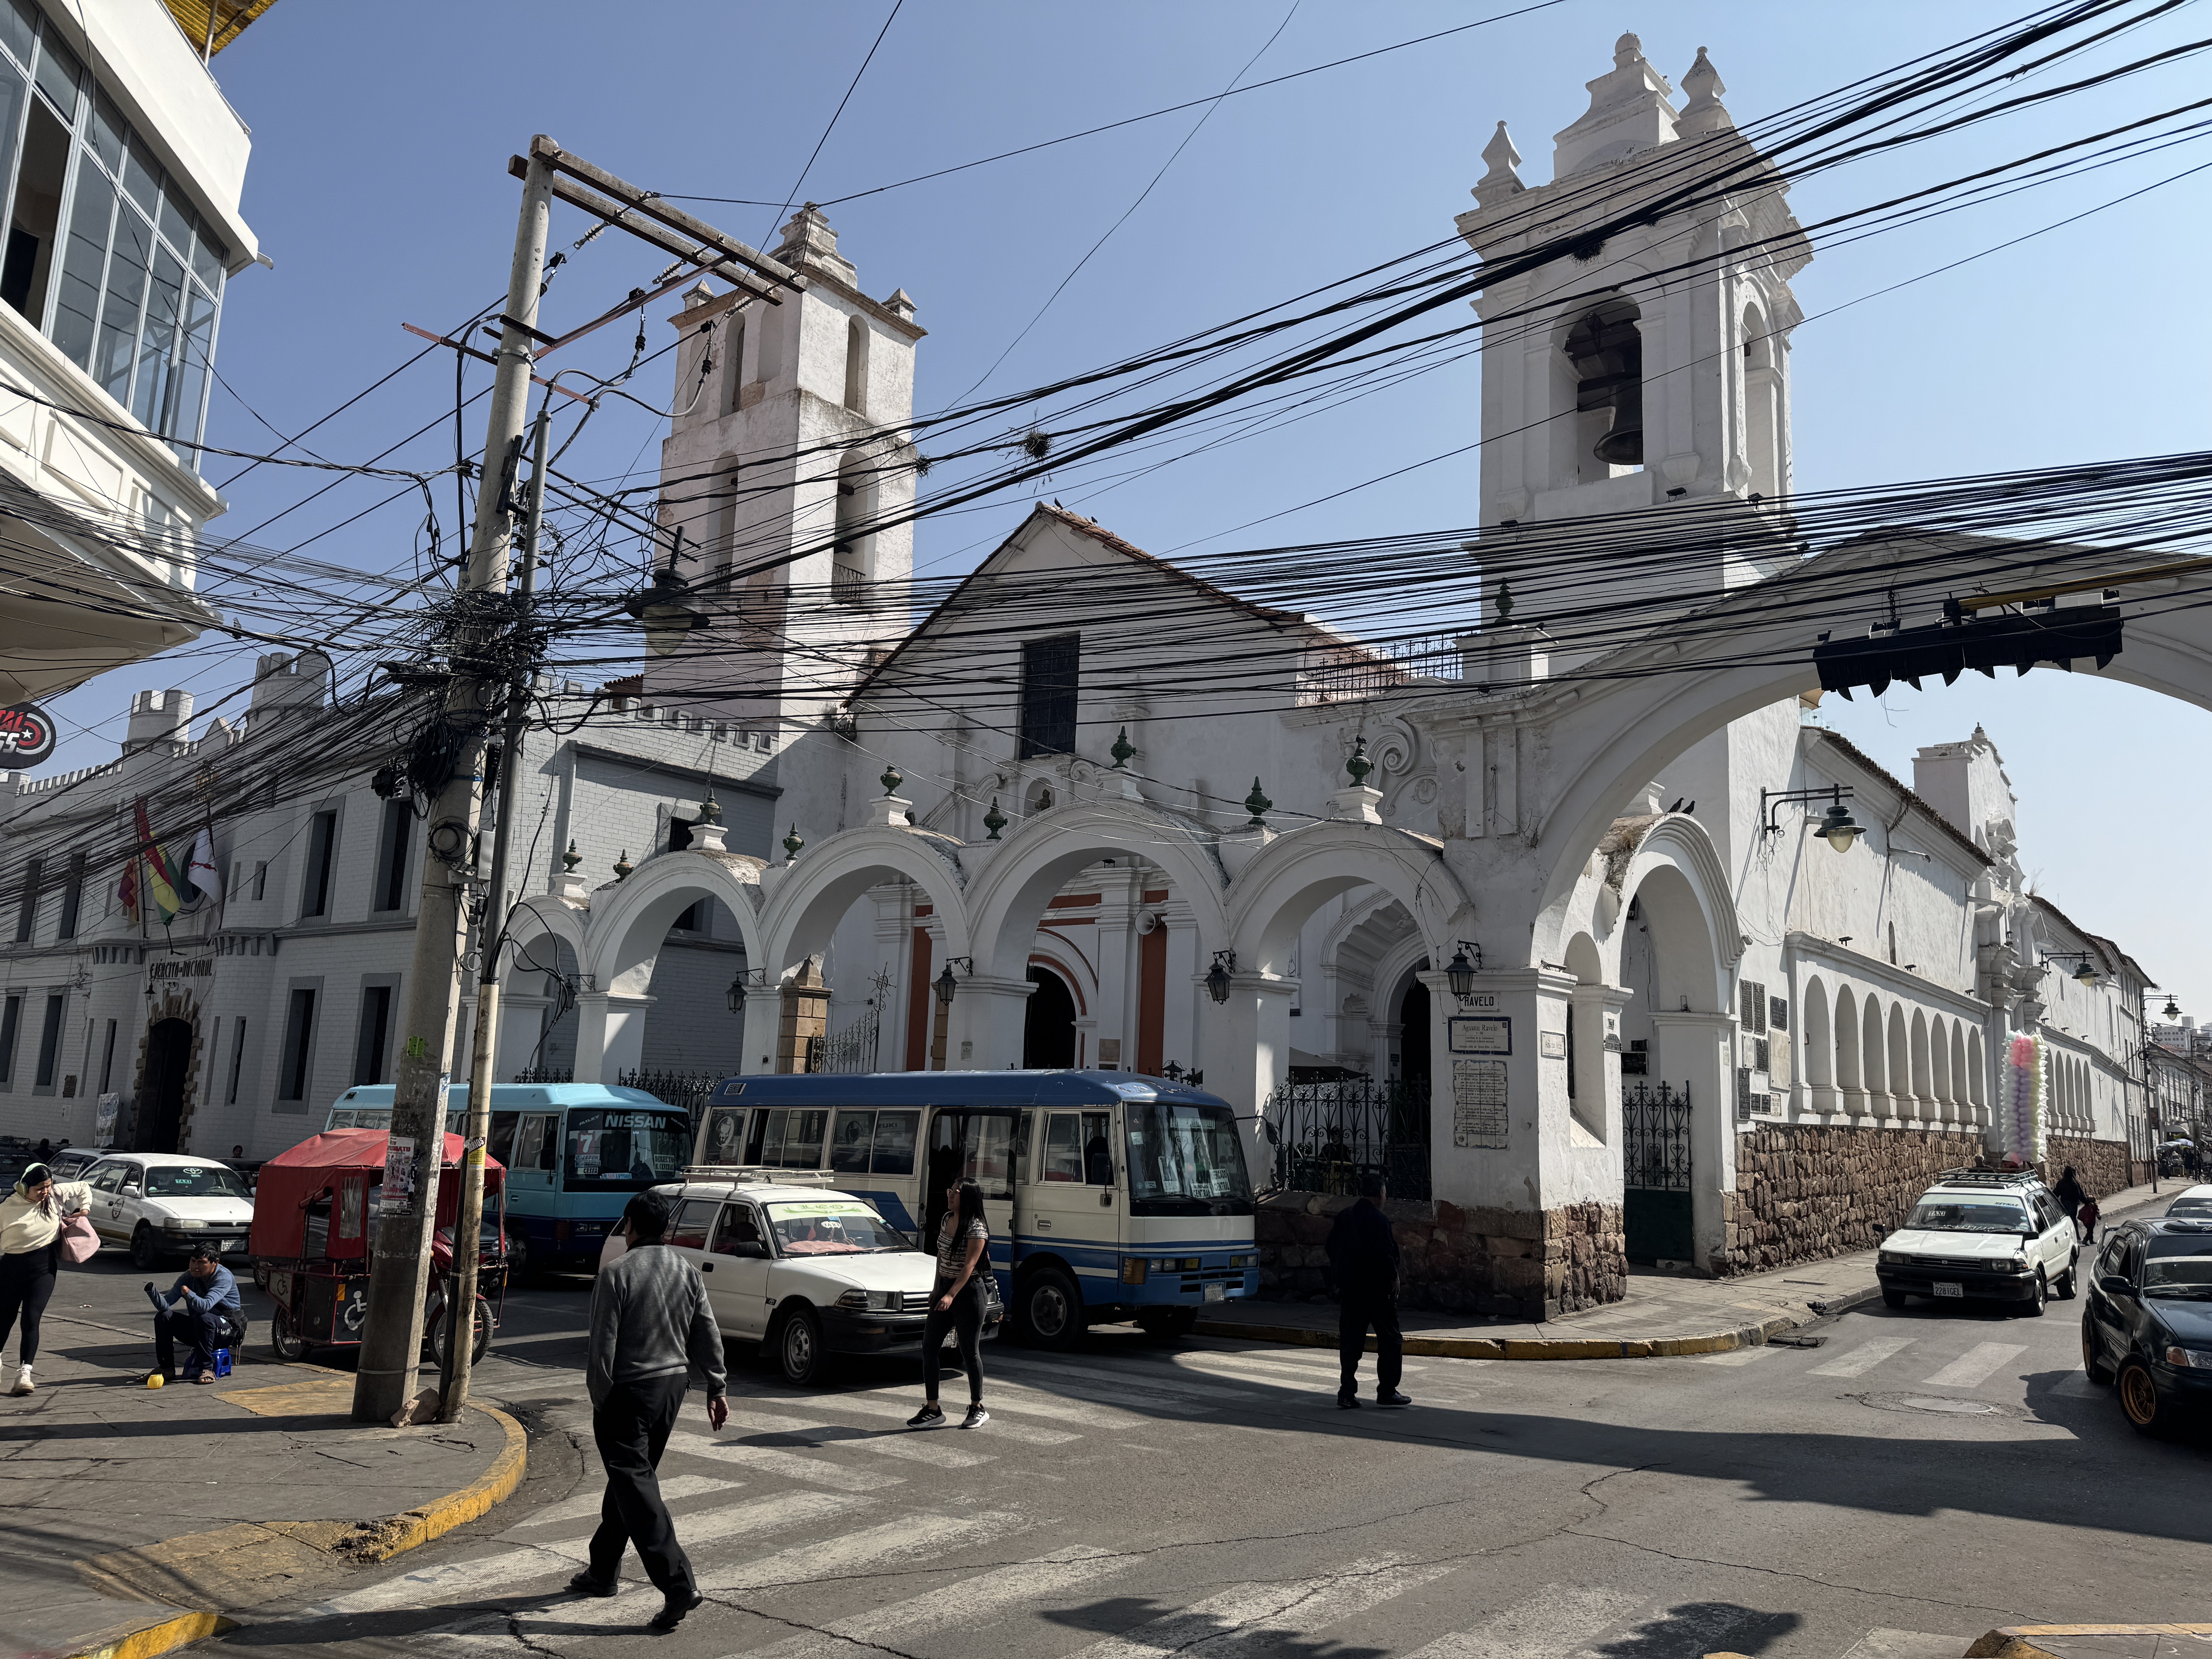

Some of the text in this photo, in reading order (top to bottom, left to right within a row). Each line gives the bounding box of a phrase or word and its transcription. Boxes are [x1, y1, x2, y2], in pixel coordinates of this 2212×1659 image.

[1465, 996, 1494, 1006] RAVELO
[605, 1115, 666, 1128] NISSAN
[580, 1134, 592, 1153] 7
[1214, 1182, 1230, 1191] CENTRAL
